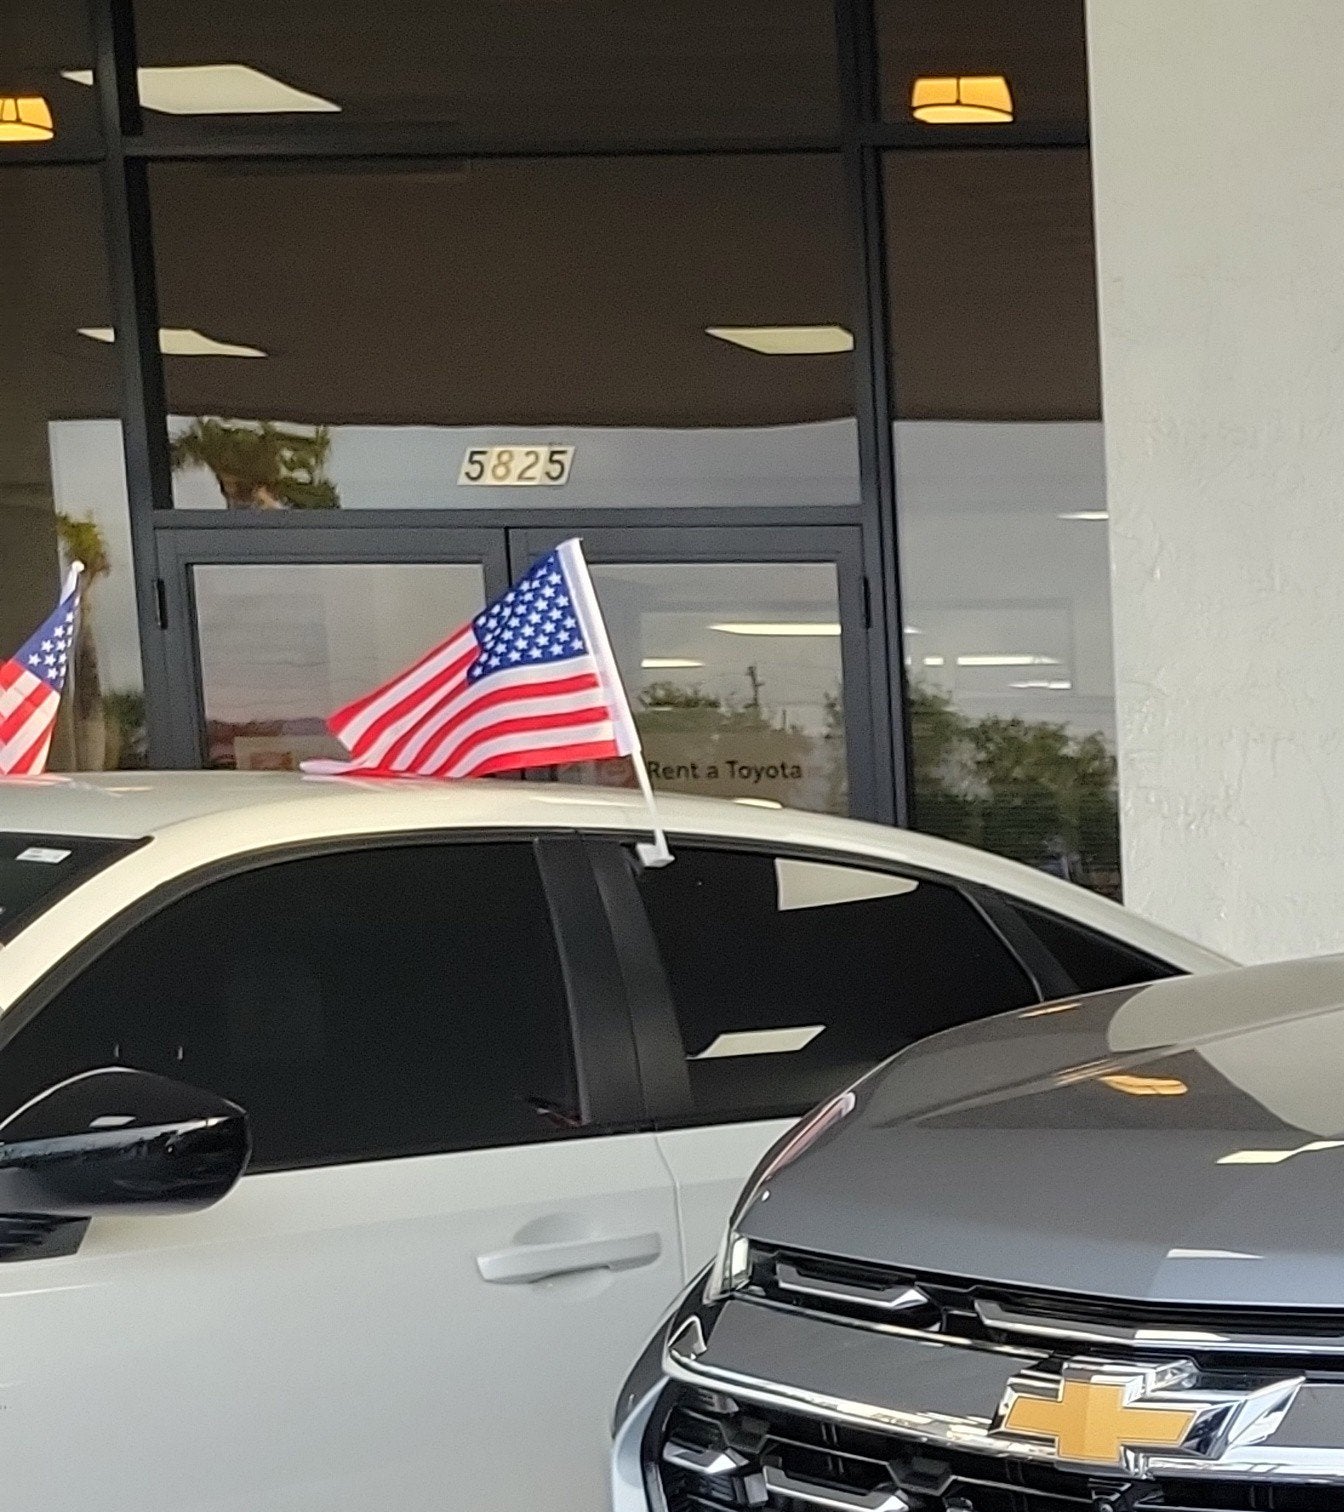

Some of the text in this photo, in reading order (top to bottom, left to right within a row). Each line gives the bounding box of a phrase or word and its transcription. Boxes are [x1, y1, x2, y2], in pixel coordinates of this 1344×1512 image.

[464, 450, 568, 481] 5825
[648, 760, 803, 783] Rent a Toyota
